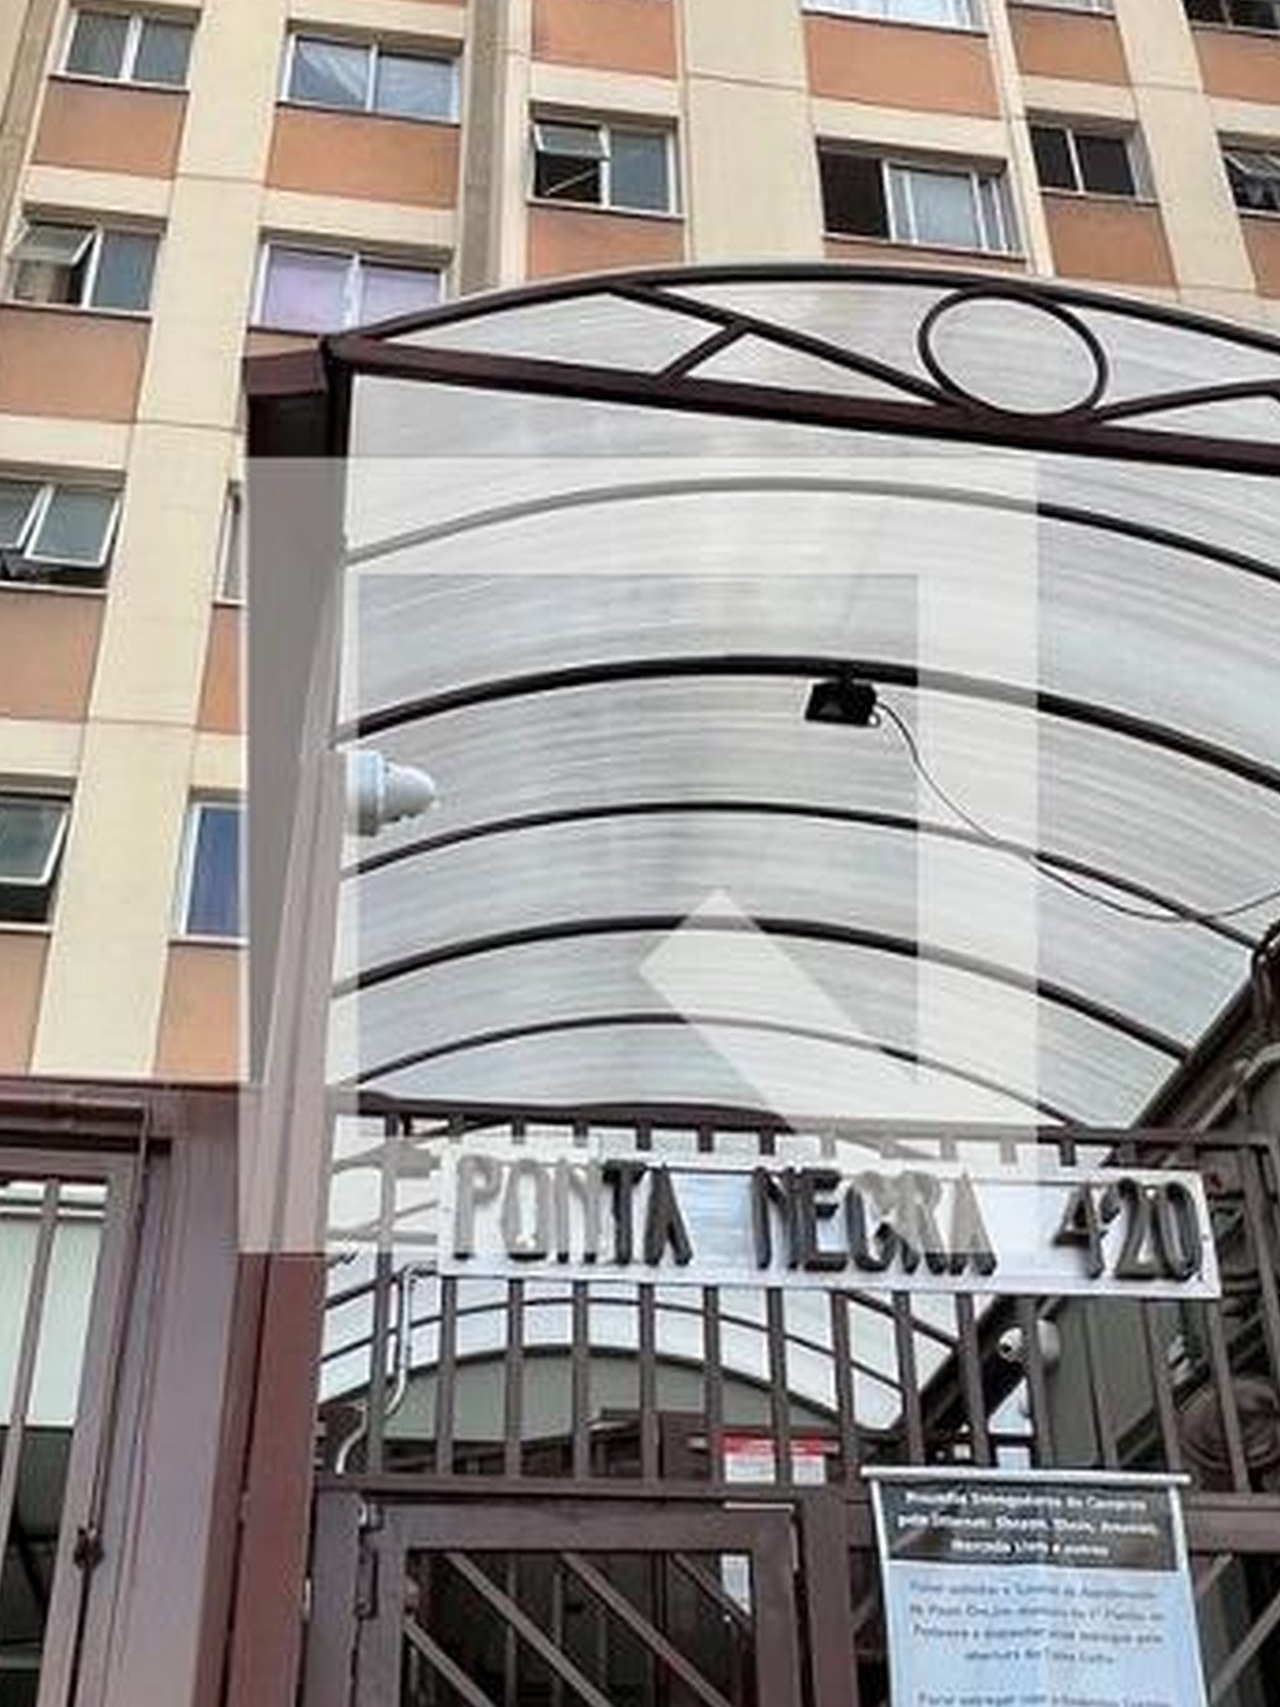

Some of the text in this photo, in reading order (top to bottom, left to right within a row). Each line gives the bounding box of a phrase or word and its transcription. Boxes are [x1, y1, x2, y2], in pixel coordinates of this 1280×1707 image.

[453, 1155, 1204, 1280] PONTA NEGRA 420
